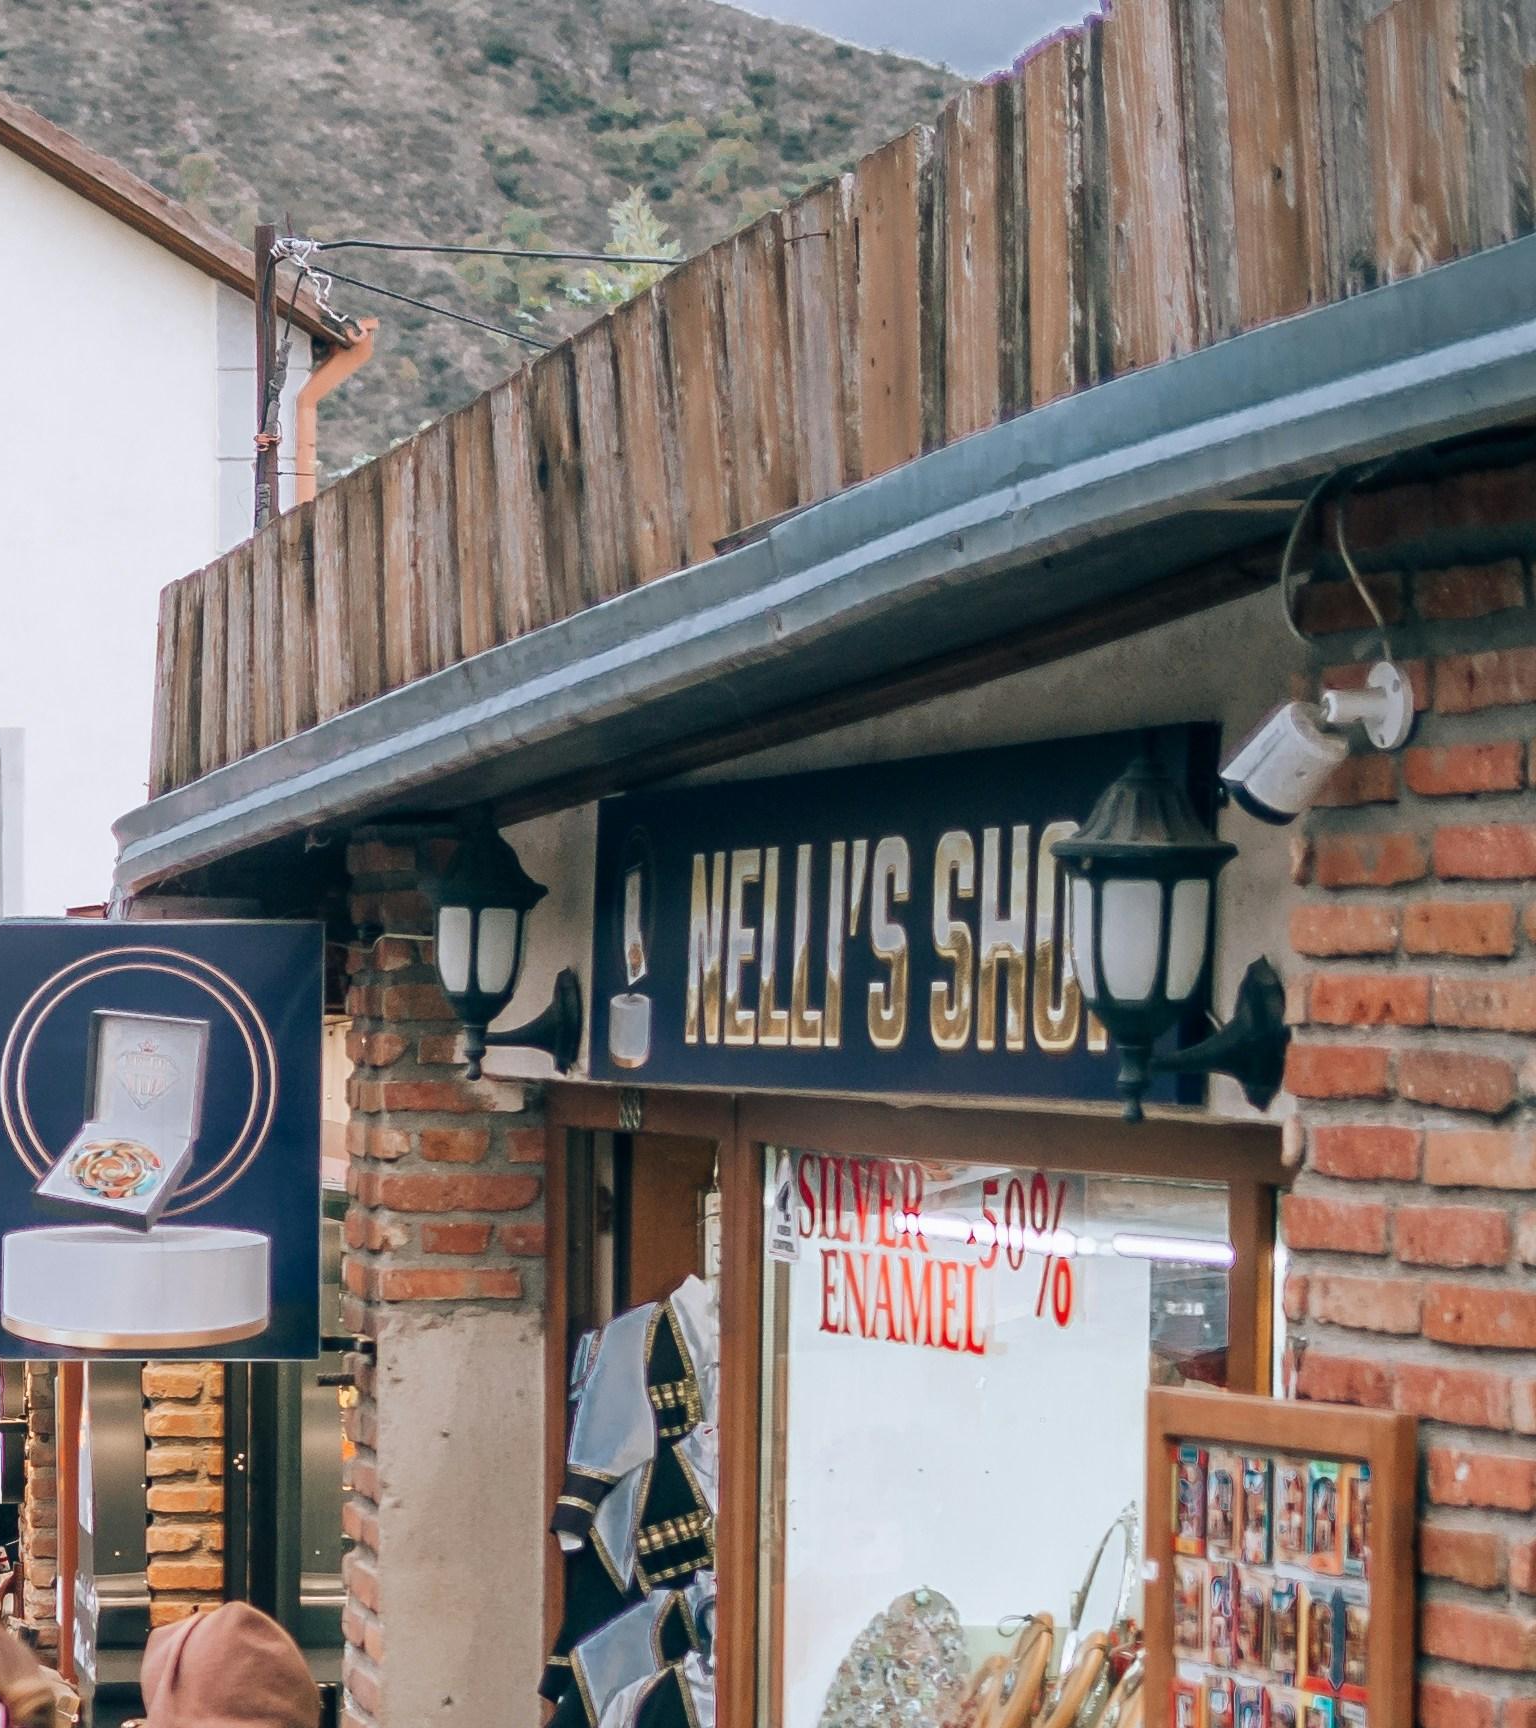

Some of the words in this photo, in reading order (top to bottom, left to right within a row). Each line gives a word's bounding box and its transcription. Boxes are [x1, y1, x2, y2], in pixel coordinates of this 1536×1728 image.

[685, 835, 911, 1050] NELLI'S
[929, 820, 1109, 1053] SHO
[797, 1152, 929, 1252] SILVER
[818, 1248, 985, 1355] ENAMEL
